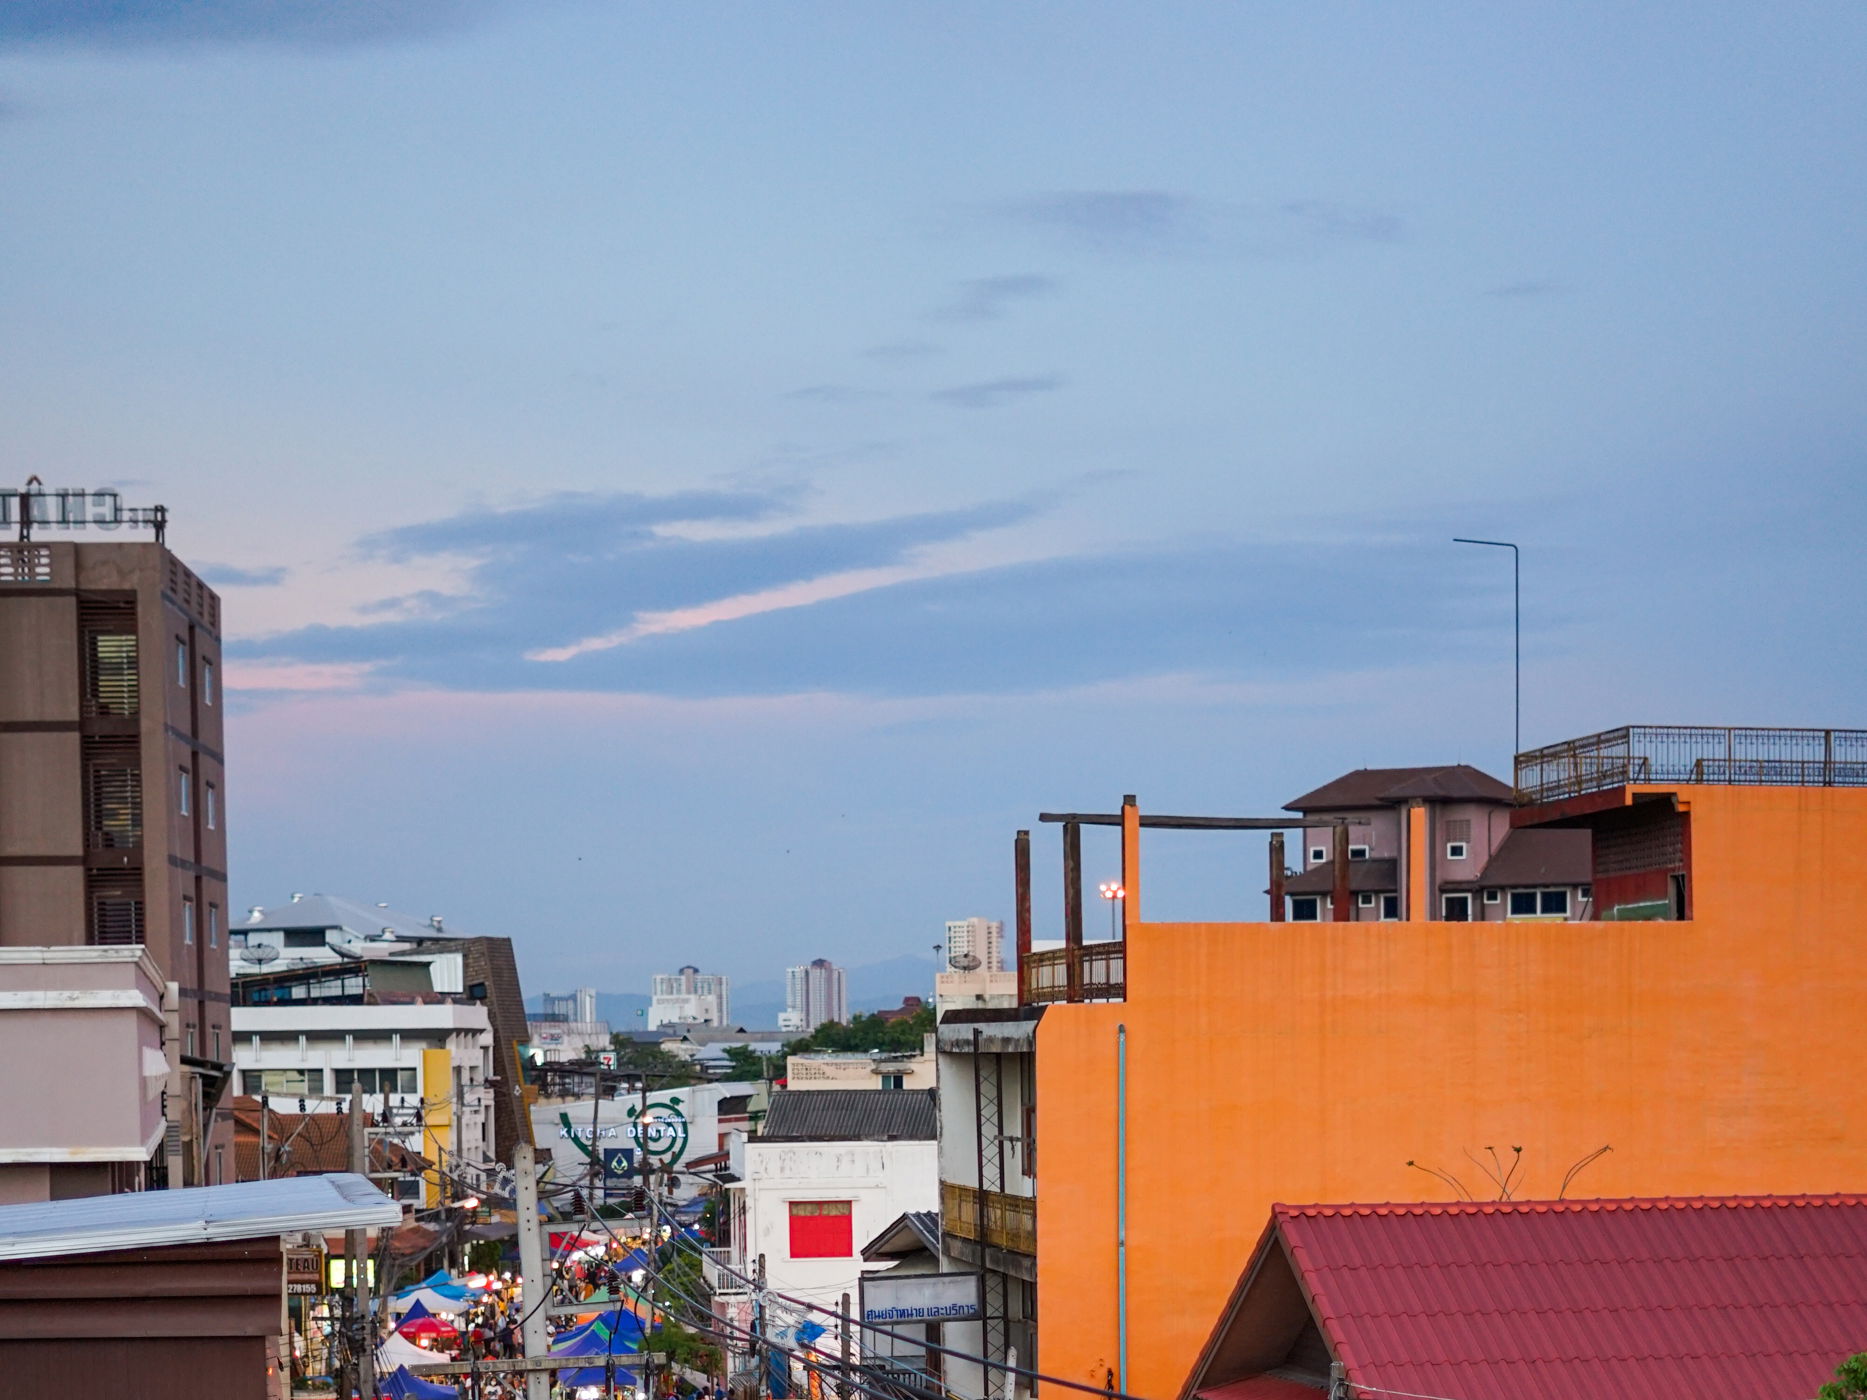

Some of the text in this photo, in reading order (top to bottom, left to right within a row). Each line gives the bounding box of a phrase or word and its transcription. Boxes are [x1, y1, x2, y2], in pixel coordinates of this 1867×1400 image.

[627, 1127, 687, 1138] DENTAL
[926, 1303, 977, 1318] และบริการ
